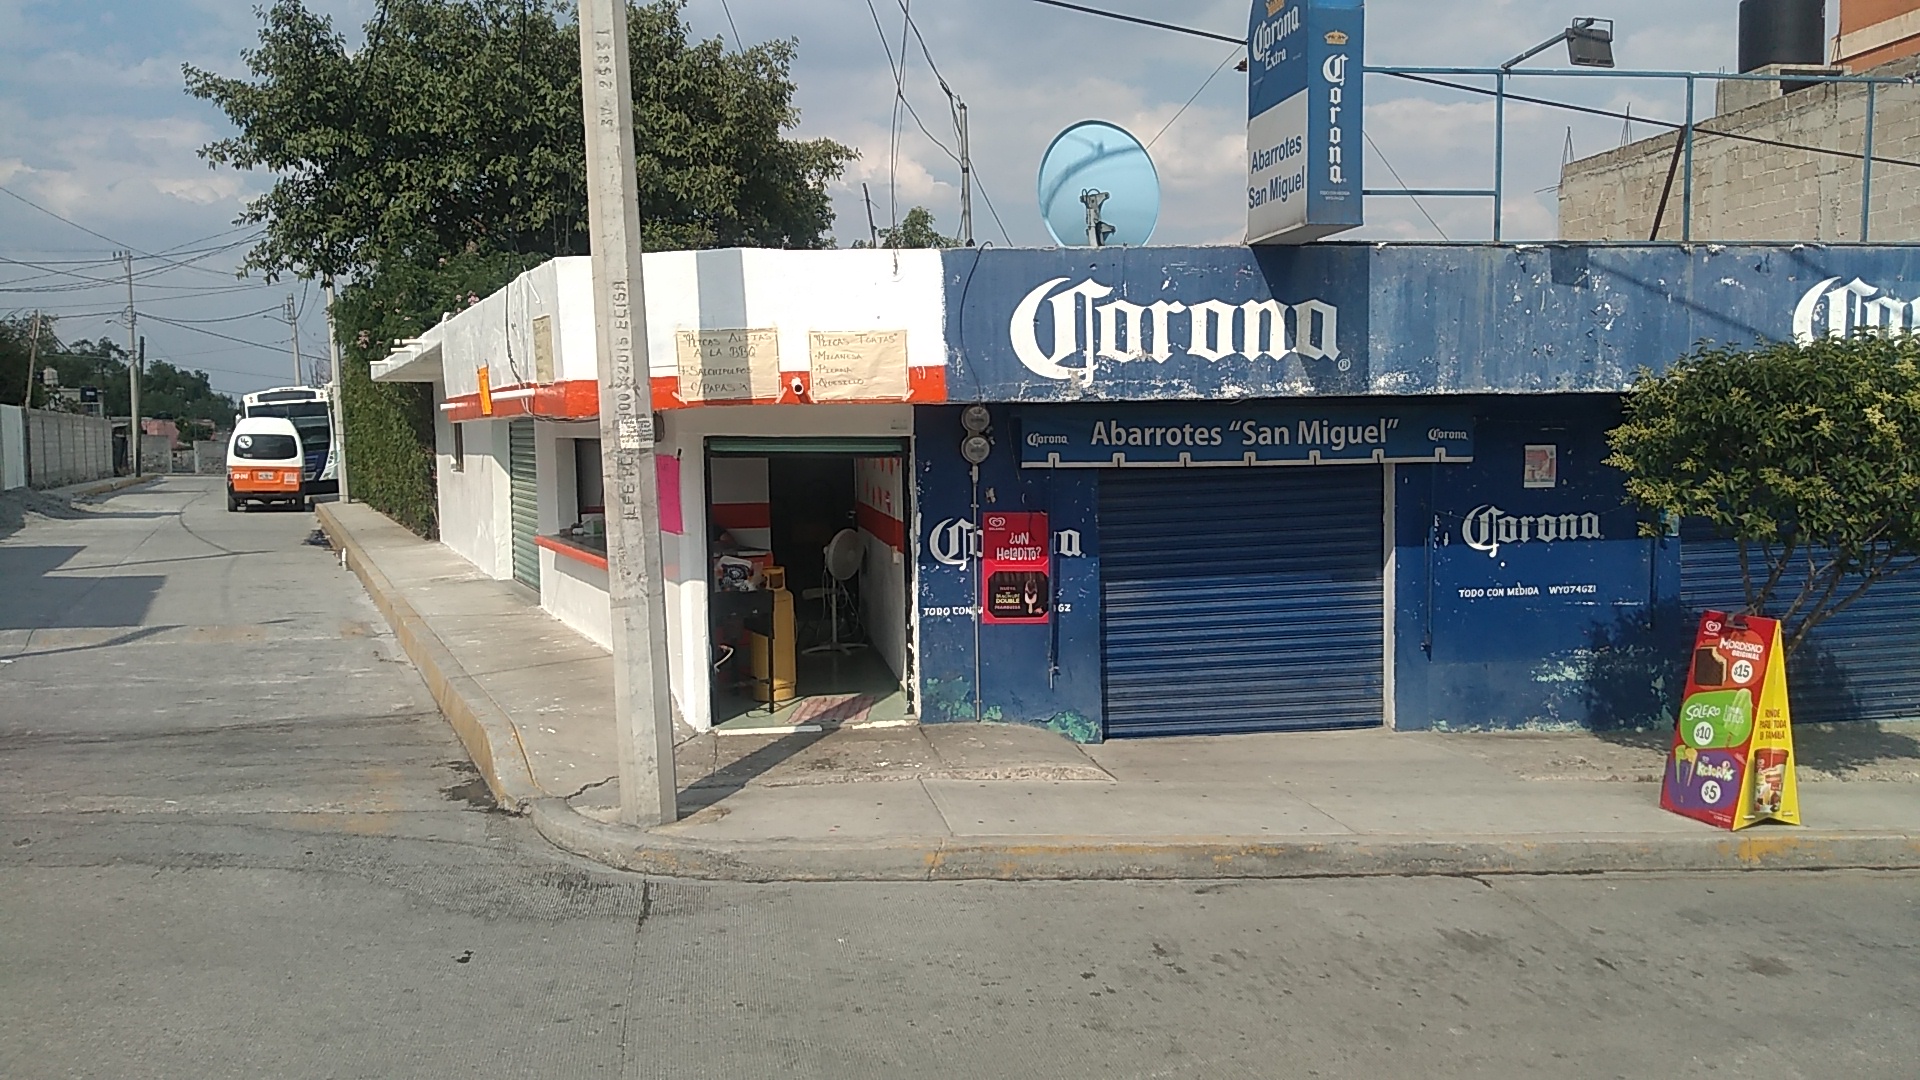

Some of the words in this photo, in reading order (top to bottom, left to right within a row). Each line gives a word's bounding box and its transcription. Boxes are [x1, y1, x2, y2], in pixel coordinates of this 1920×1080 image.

[1253, 6, 1300, 62] Corona
[1266, 48, 1286, 71] Extra
[1322, 54, 1349, 184] Corona
[1251, 135, 1302, 175] Abarrotes
[1248, 186, 1267, 210] San
[1270, 165, 1305, 203] Miguel
[1010, 277, 1341, 388] Corona
[709, 349, 722, 357] LA
[1027, 433, 1069, 447] Corona
[1090, 420, 1222, 446] Abarrotes
[1428, 428, 1468, 442] Corona
[1462, 504, 1601, 558] Corona
[1459, 588, 1484, 598] TODO
[1486, 587, 1505, 597] CON
[1506, 586, 1540, 596] MEDIDA
[923, 607, 950, 616] TODO
[1733, 662, 1751, 679] $15
[1695, 725, 1711, 741] $10
[1703, 784, 1718, 800] $5
